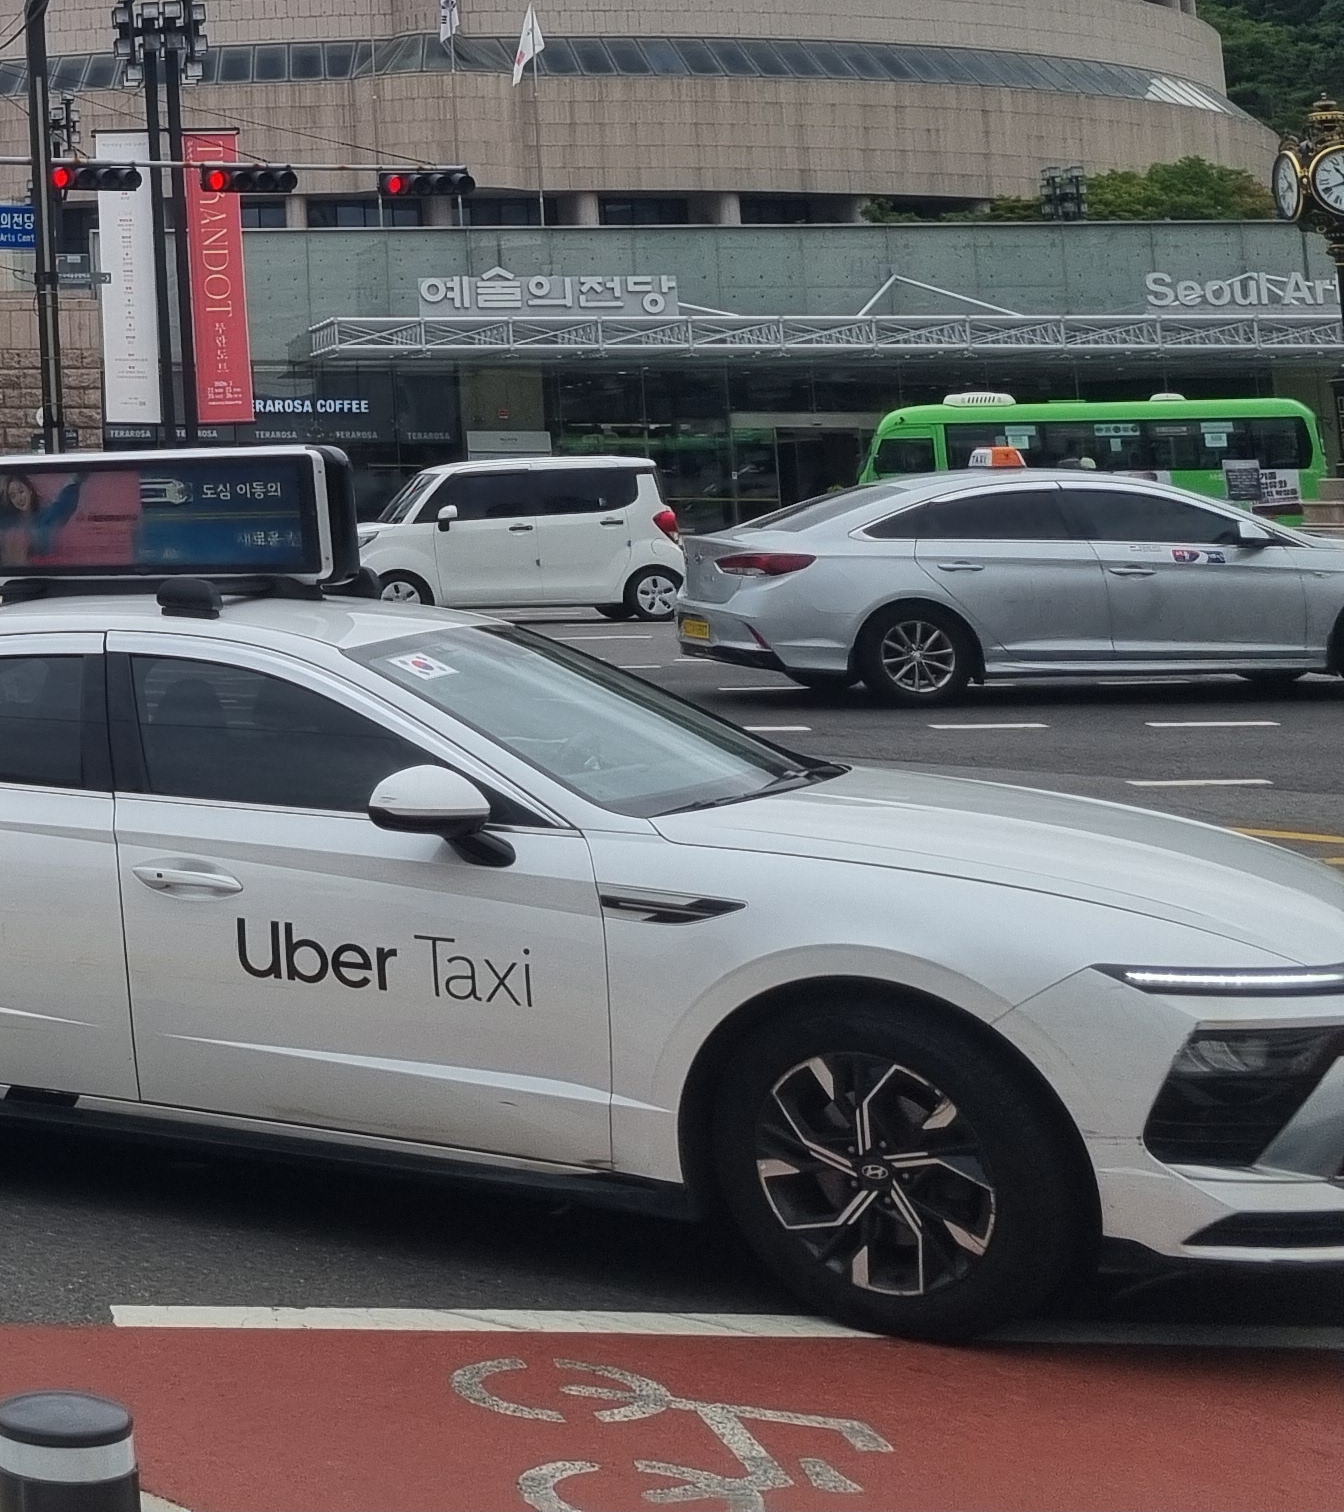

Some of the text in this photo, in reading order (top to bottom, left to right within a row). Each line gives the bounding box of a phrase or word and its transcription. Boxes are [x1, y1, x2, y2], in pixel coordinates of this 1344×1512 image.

[0, 232, 16, 242] Arts
[17, 232, 35, 242] Cent
[419, 266, 677, 314] 예술의전당
[1145, 272, 1341, 306] Seoul Art
[252, 399, 369, 414] RAROSA COFFEE
[110, 429, 151, 438] TERAROSA
[176, 429, 218, 438] TEROSA
[255, 430, 298, 439] TERAROSA
[201, 482, 231, 500] 도심
[236, 917, 533, 1008] Uber Taxi
